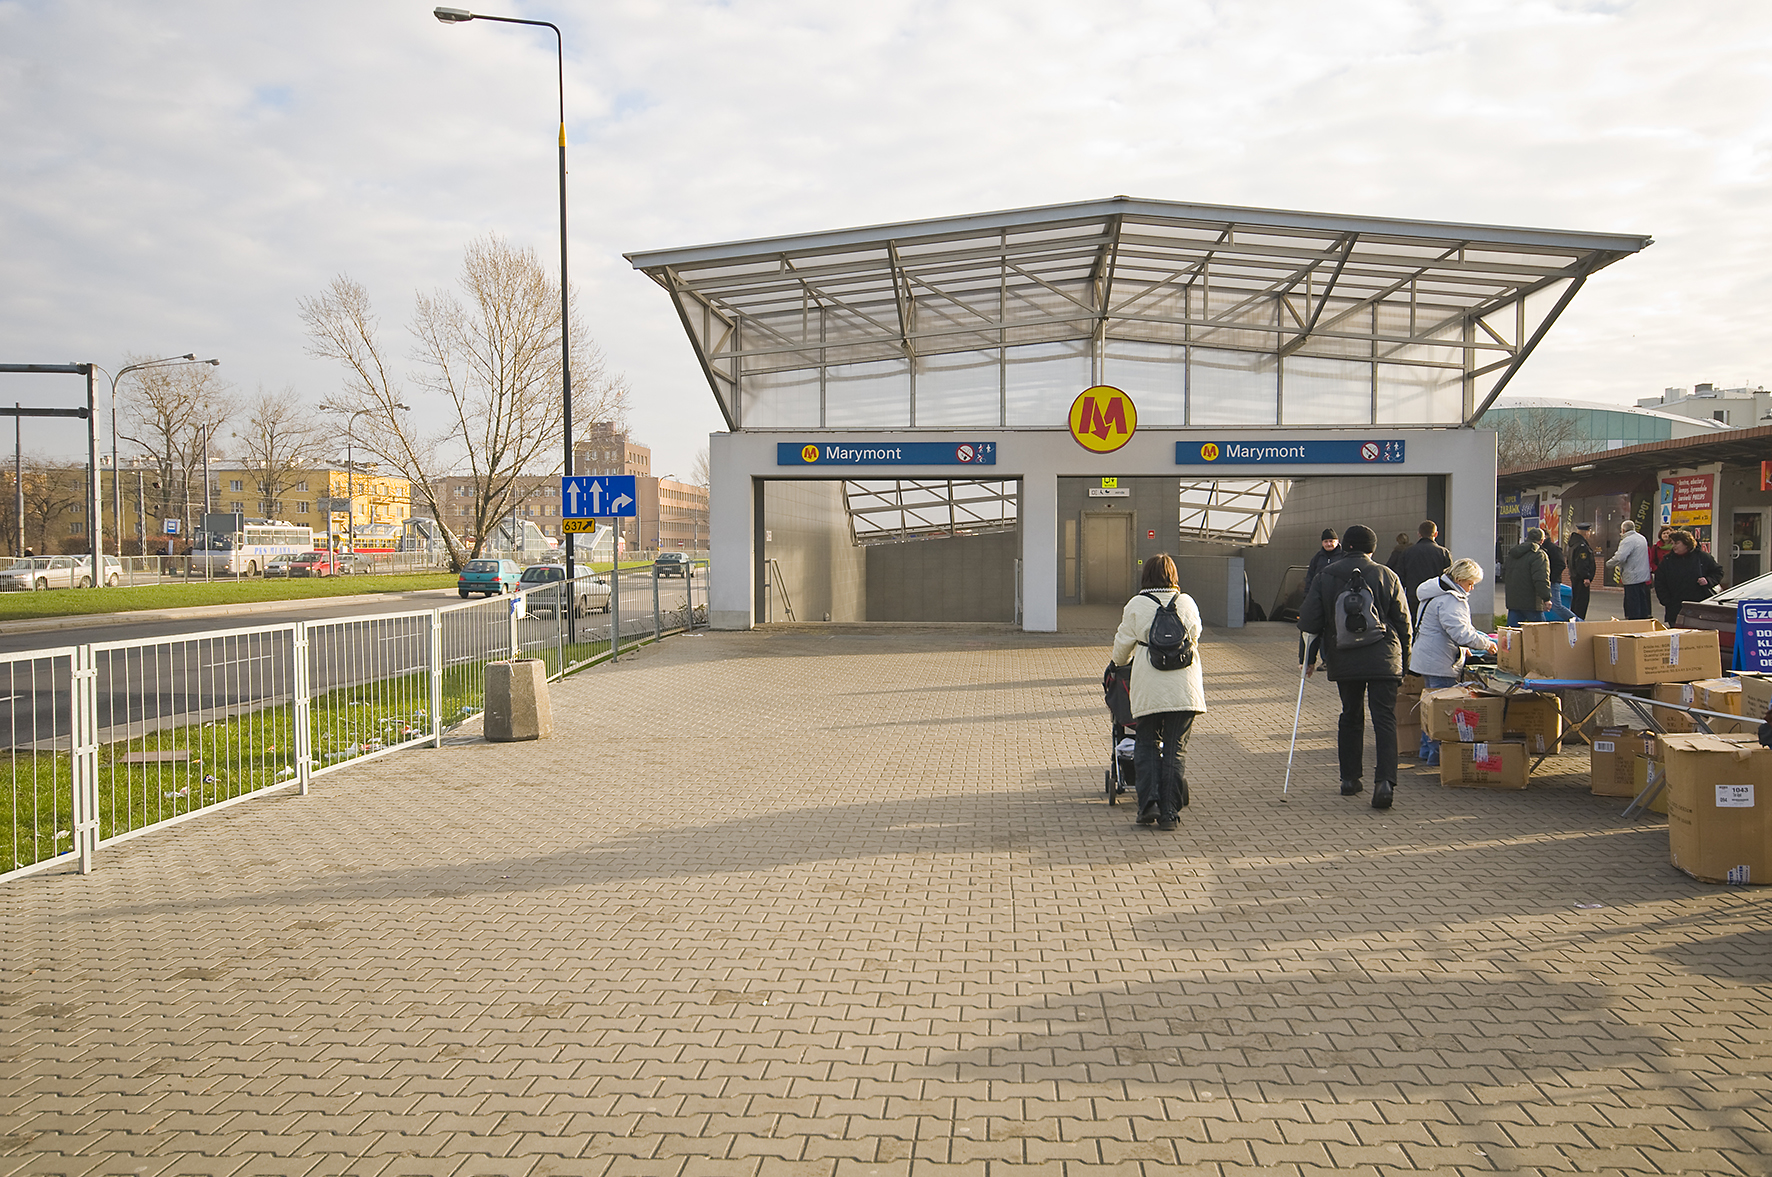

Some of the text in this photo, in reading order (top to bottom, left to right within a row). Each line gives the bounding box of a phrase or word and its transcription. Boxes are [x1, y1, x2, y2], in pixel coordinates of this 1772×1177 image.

[1079, 397, 1128, 441] M
[826, 446, 902, 463] Marymont
[1226, 444, 1305, 461] Marymont
[1567, 504, 1575, 527] SPOT
[1637, 499, 1651, 520] SPOT
[565, 521, 582, 531] 637
[255, 547, 267, 555] PKS
